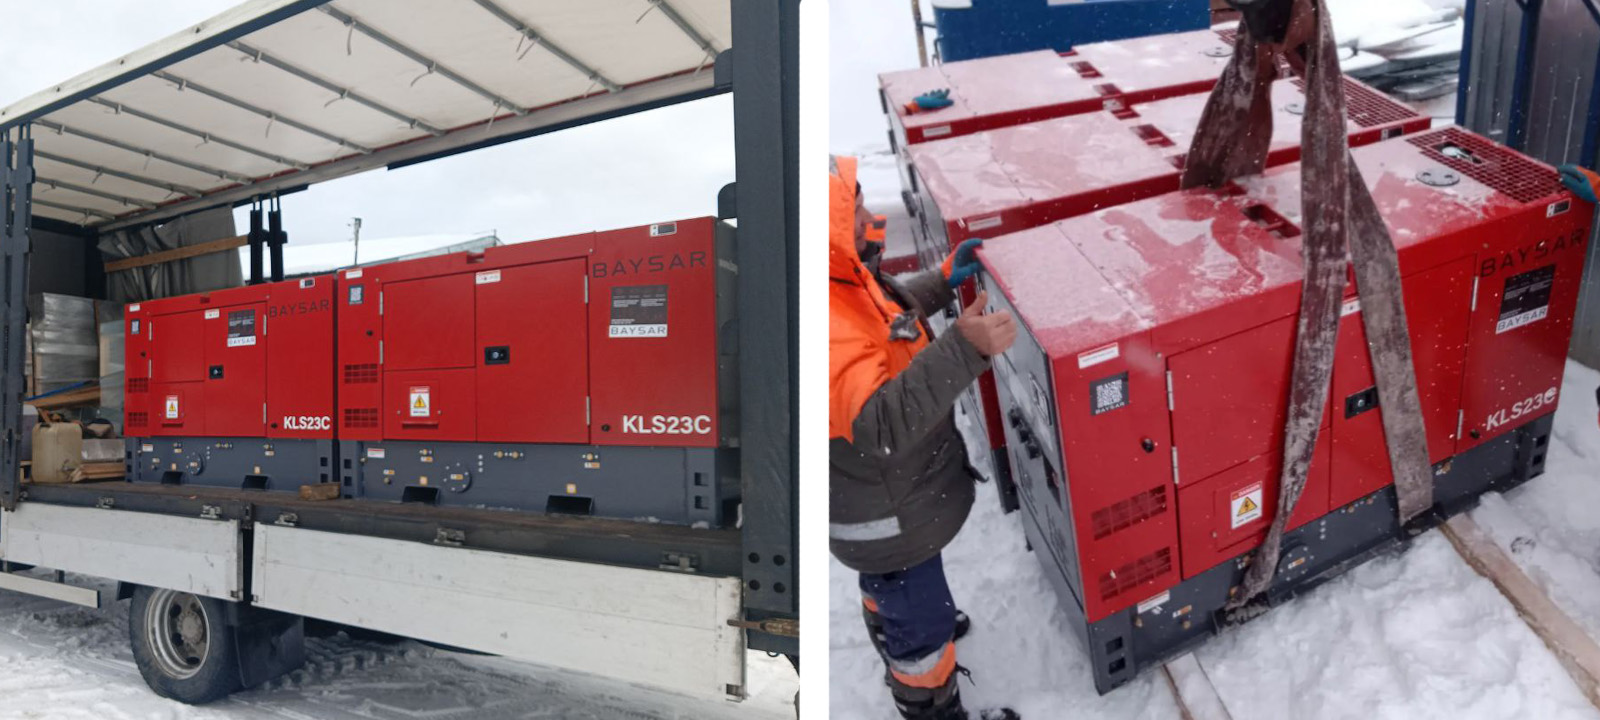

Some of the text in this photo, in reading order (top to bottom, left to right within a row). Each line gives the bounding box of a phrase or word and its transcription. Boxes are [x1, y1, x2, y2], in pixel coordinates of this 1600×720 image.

[1481, 229, 1584, 278] BAYSAR
[592, 251, 706, 278] BAYSAR
[269, 299, 329, 318] BAYSAR
[1498, 307, 1547, 331] BAYSAR
[611, 326, 666, 336] BAYSAR
[283, 416, 330, 430] KLS23C
[622, 415, 711, 434] KLS23C
